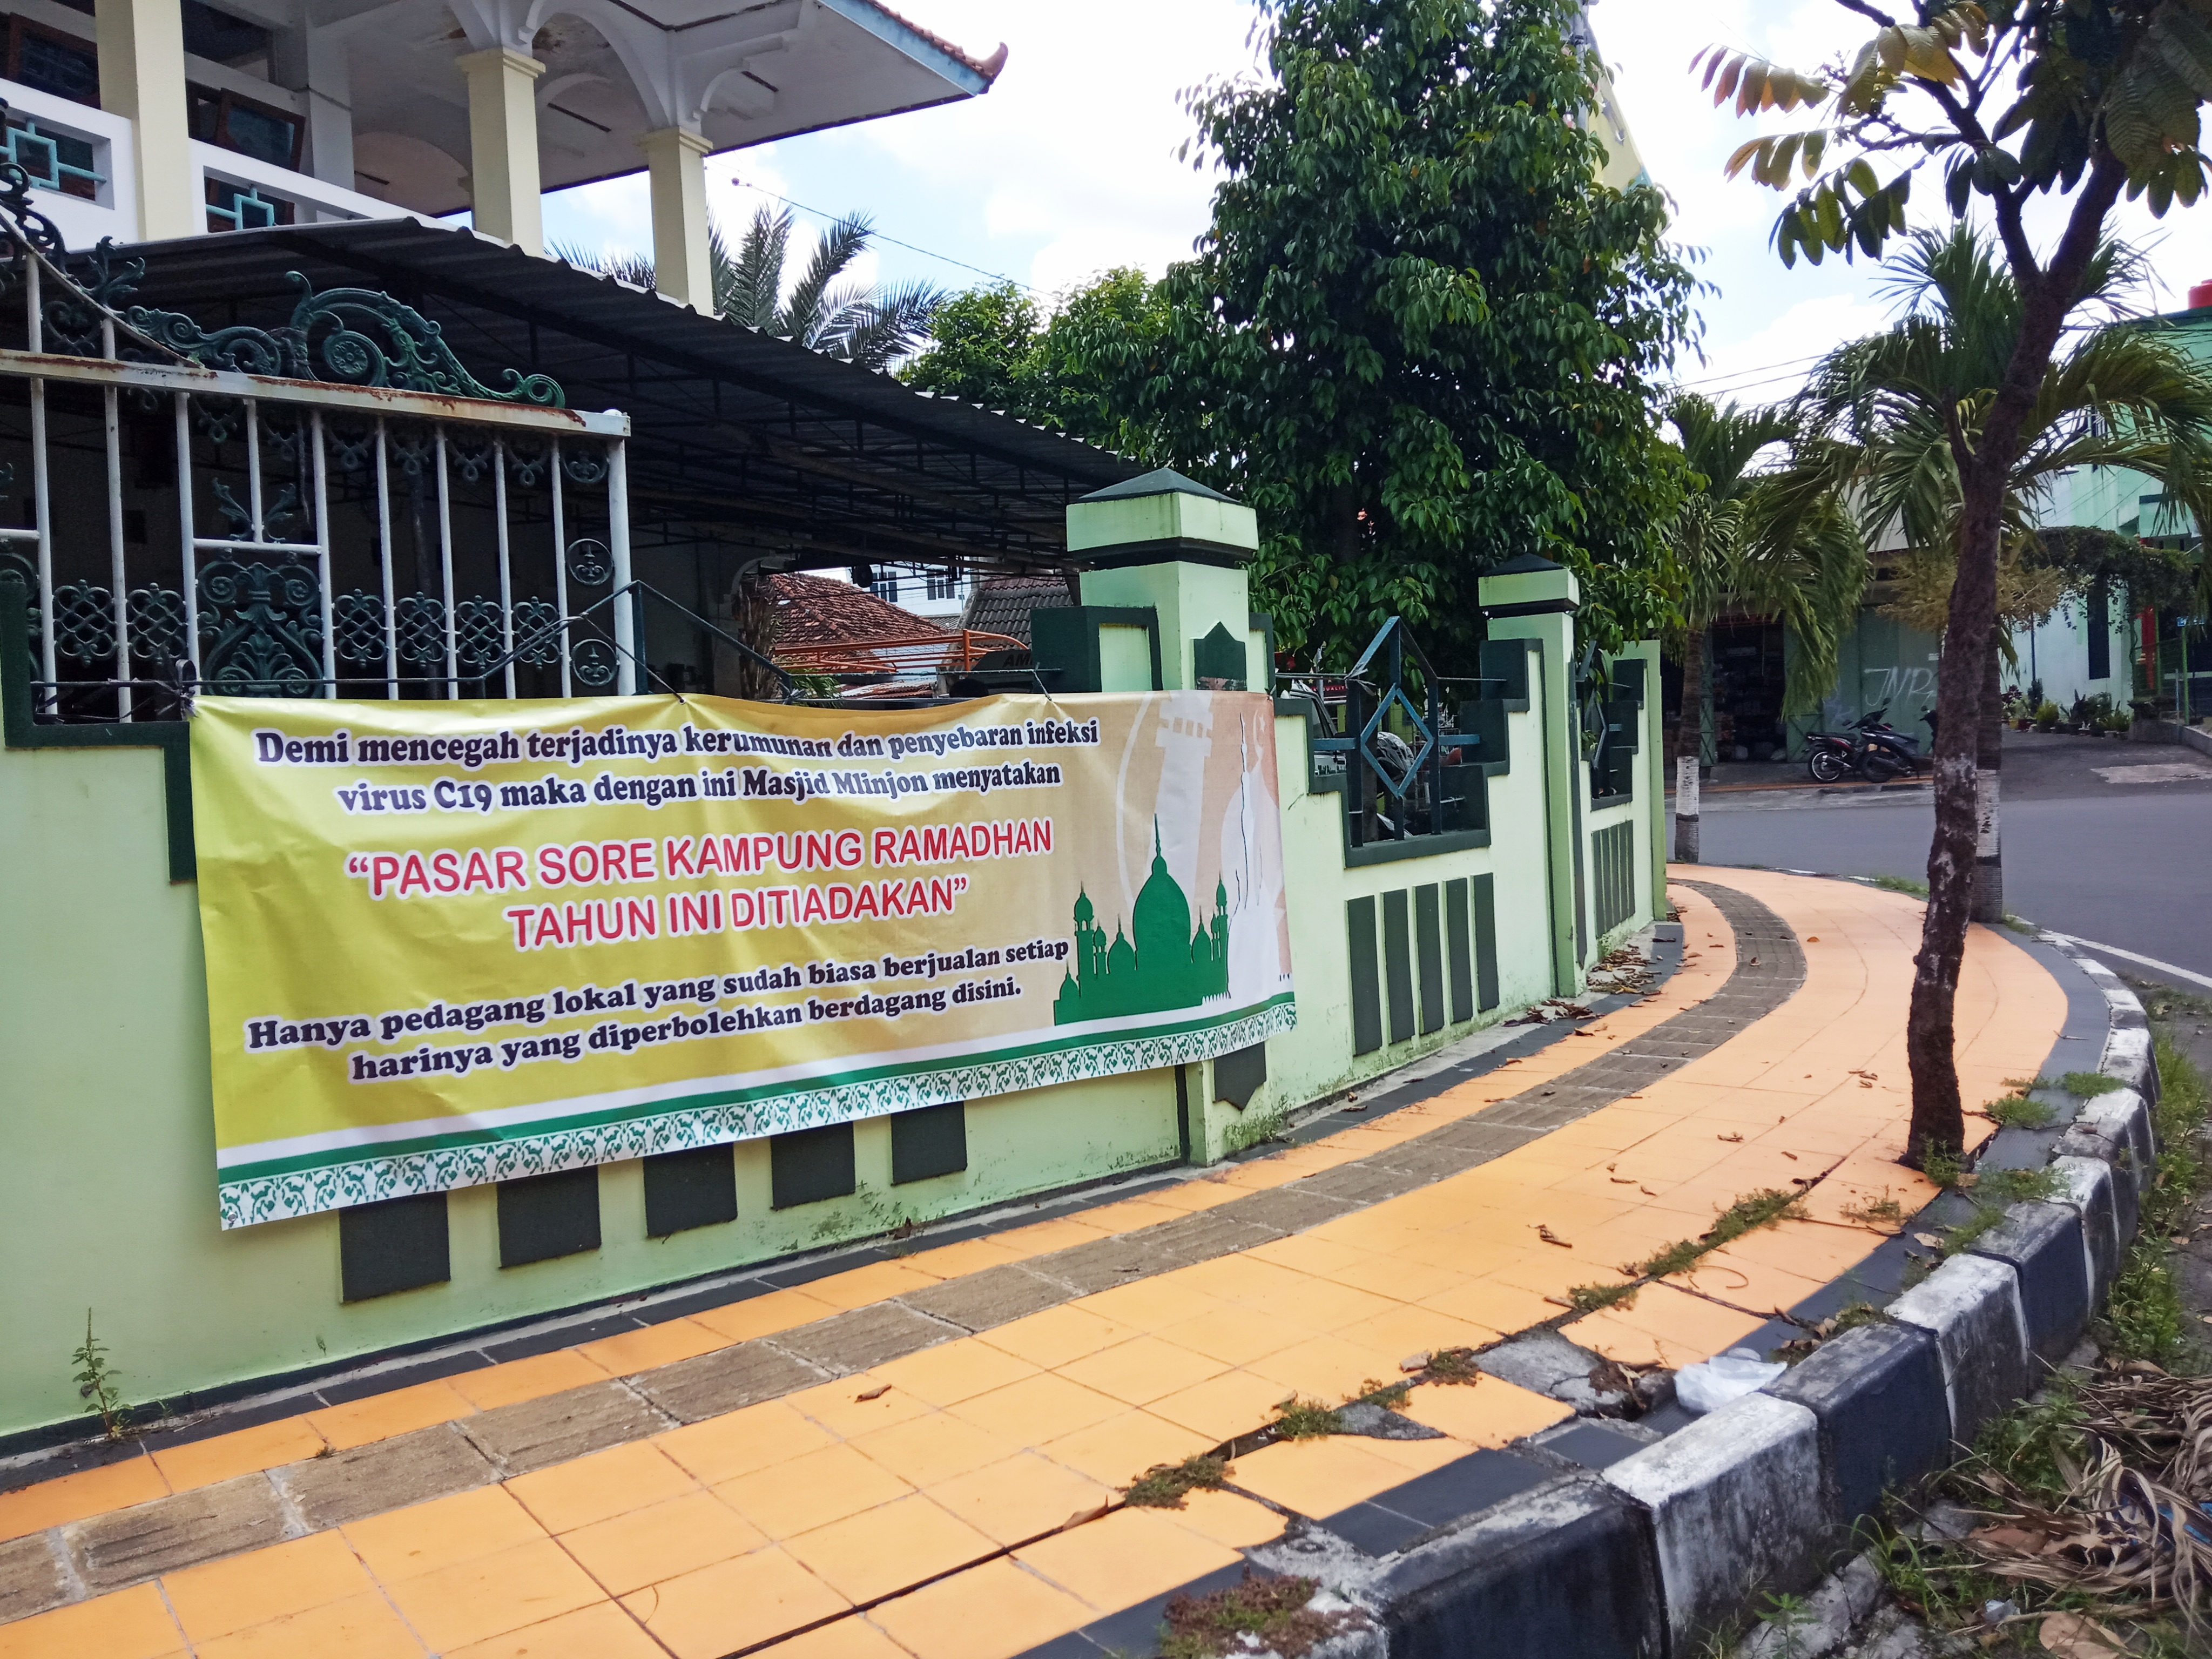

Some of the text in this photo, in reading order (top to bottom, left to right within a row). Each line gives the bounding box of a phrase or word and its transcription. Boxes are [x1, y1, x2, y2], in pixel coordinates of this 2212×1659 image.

[1003, 653, 1033, 667] AM
[257, 716, 1098, 767] Demi mencegah terjadinya kerumunan dan penyebaran infeksi
[339, 761, 1060, 811] virus C19 maka dengan ini Masjid Mlinjon menyatakan
[540, 843, 654, 884] SORE
[668, 833, 861, 875] KAMPUNG
[875, 821, 1050, 864] RAMADHAN
[508, 900, 655, 947] TAHUN
[670, 894, 720, 932] INI
[248, 940, 1068, 1048] Hanya pedagang lokal yang sudah biasa berjualan setiap
[352, 976, 1021, 1080] harinya yang diperbolehkan berdagang disini.
